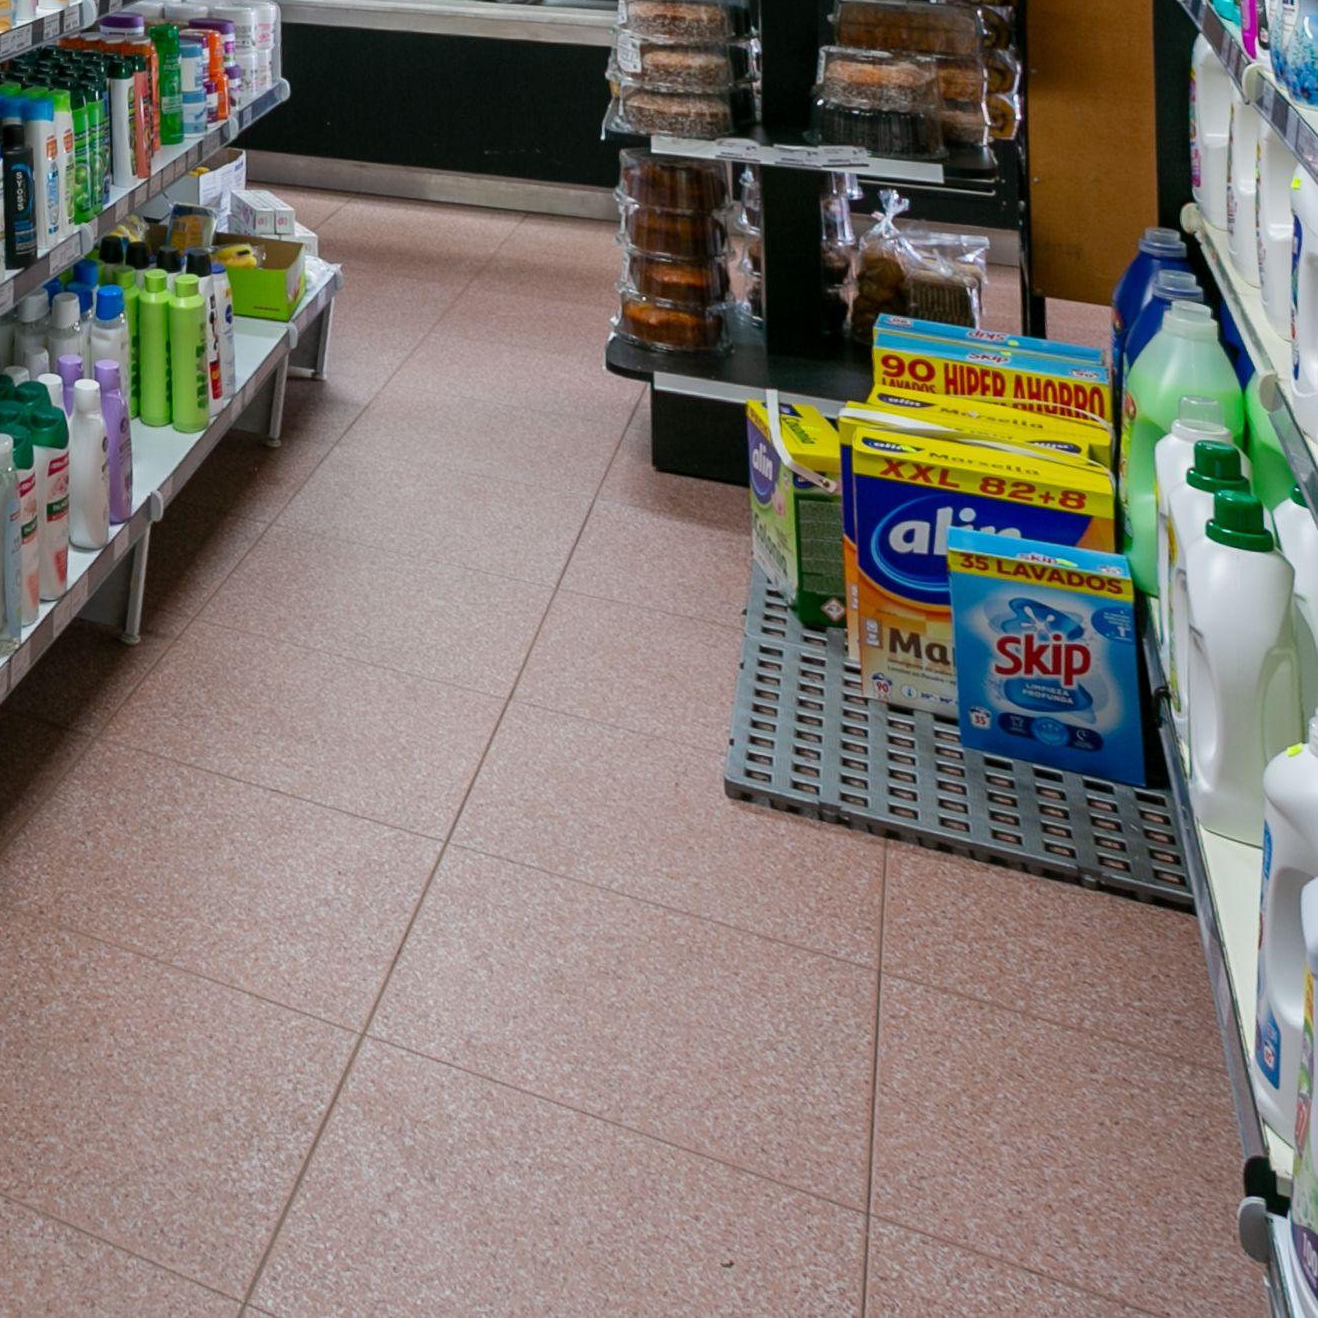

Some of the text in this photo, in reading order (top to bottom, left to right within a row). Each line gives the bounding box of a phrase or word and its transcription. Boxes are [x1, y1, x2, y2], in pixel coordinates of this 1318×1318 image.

[16, 170, 24, 212] SYOSS
[881, 354, 1105, 423] 90 HIPER AHORRO
[752, 442, 773, 481] alin
[879, 458, 1087, 510] XXL 82+8
[960, 553, 1123, 595] 35 LAVADOS
[995, 634, 1091, 686] Skip
[875, 681, 889, 693] 90
[1022, 688, 1074, 705] PROFUNDA
[973, 715, 986, 726] 35
